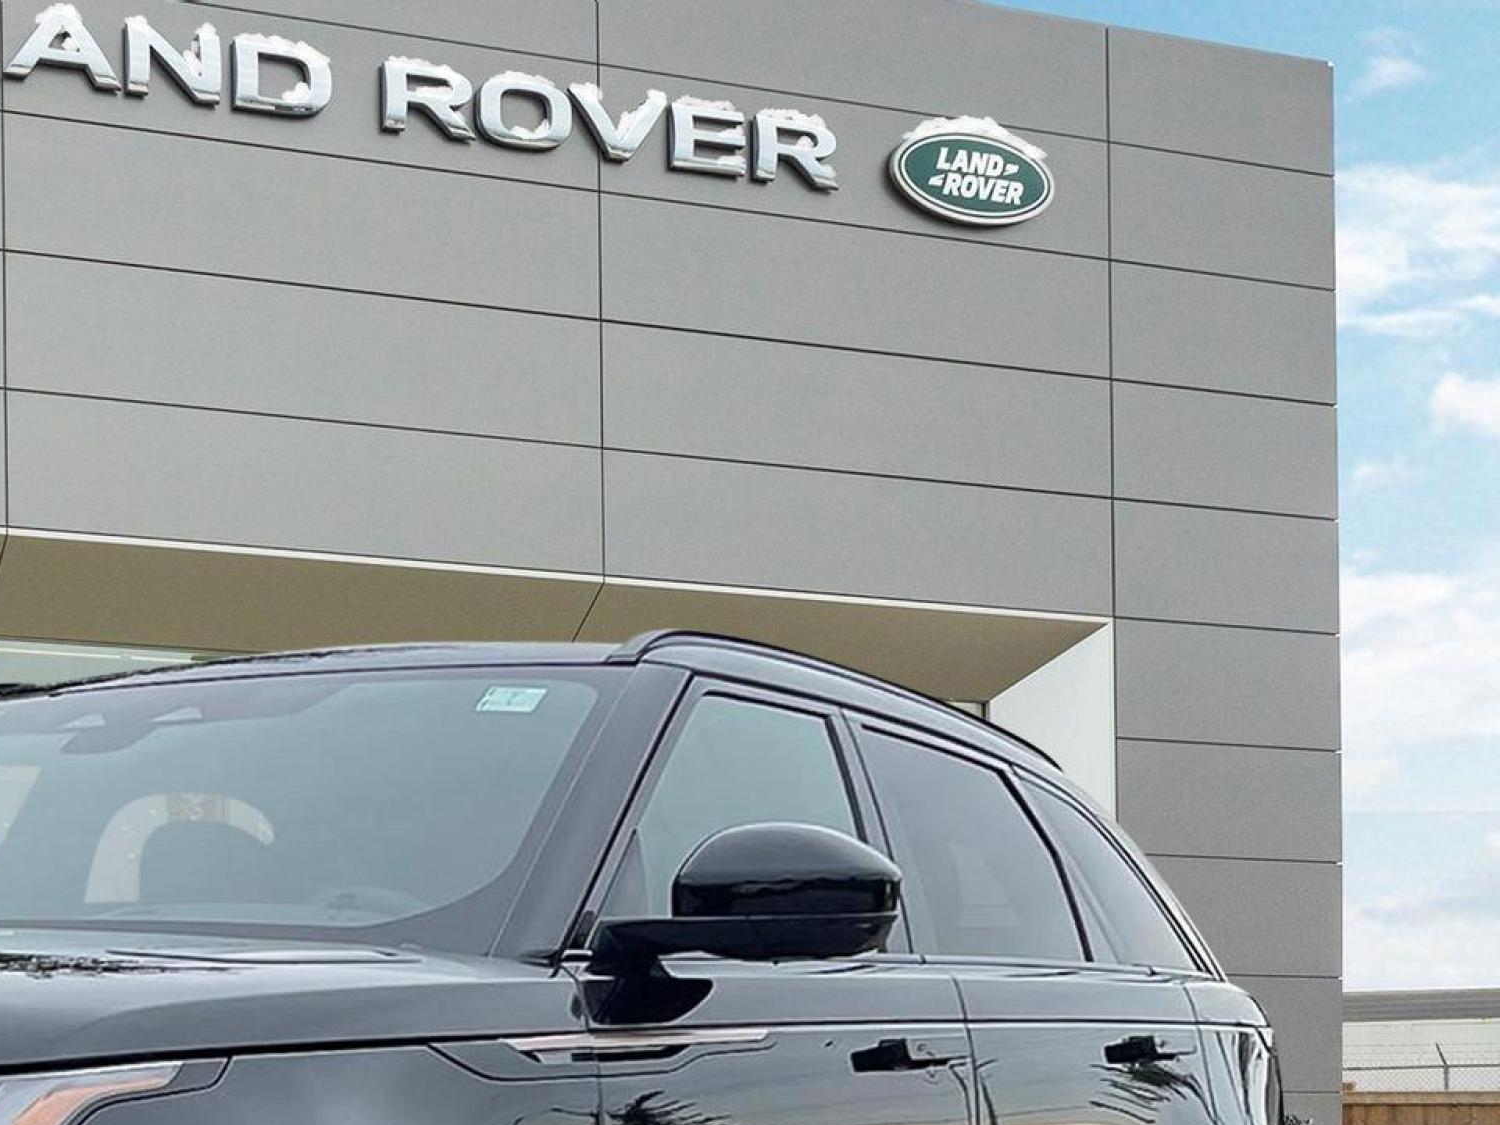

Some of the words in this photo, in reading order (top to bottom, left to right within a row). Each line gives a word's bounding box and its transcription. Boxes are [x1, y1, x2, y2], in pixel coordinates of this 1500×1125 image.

[378, 56, 838, 192] ROVER
[936, 147, 1004, 176] LAND
[942, 172, 1024, 205] ROVER
